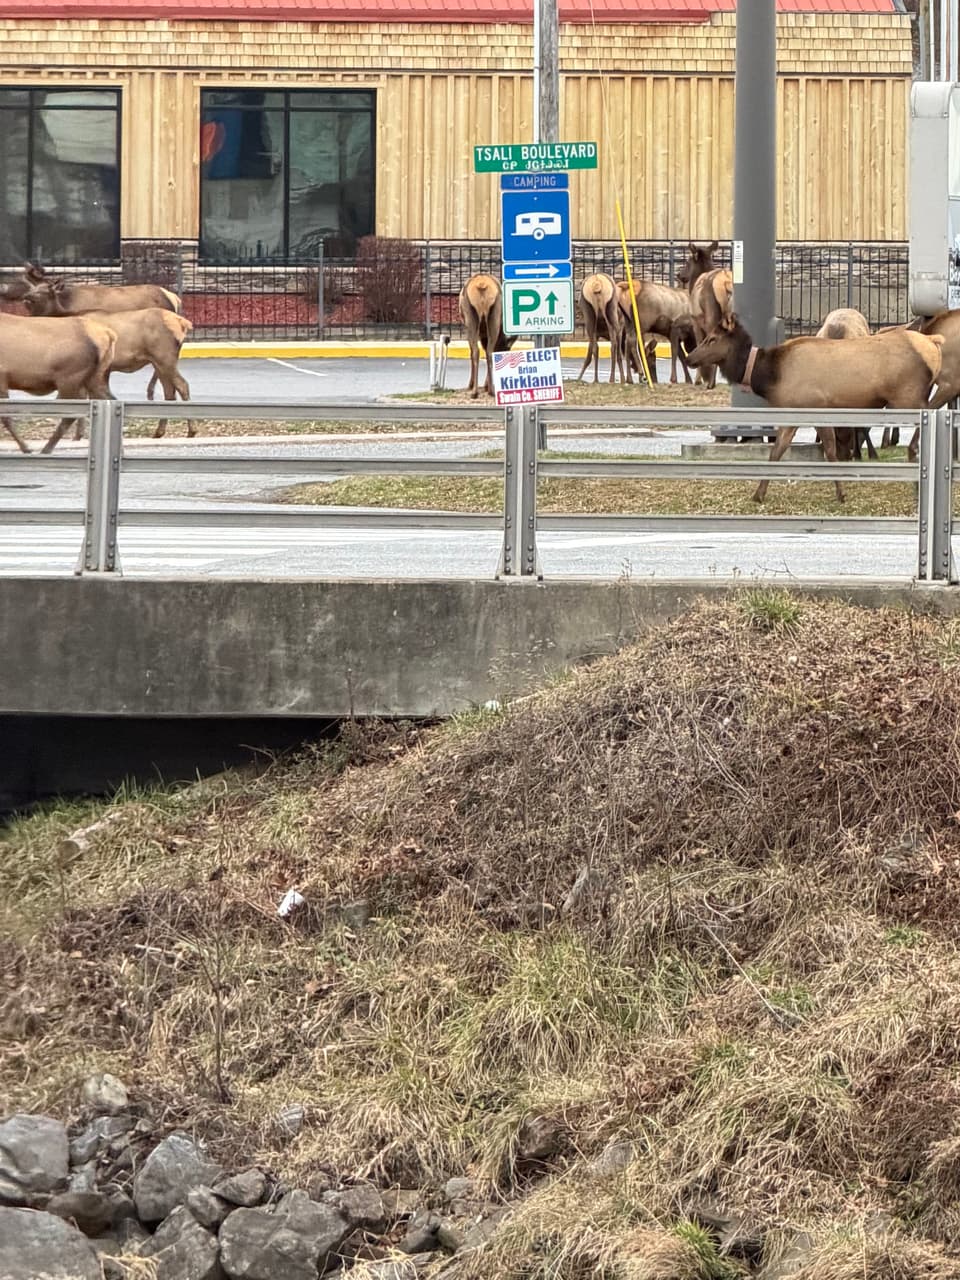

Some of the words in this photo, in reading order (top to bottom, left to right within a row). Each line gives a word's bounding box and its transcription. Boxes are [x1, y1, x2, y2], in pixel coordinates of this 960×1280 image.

[476, 146, 513, 161] TSALI
[521, 144, 596, 160] BOULEVARD
[513, 176, 557, 187] CAMPING
[526, 349, 558, 363] ELECT
[518, 365, 538, 374] Brian
[500, 373, 557, 390] Kirkland
[534, 388, 560, 401] SHERIFF
